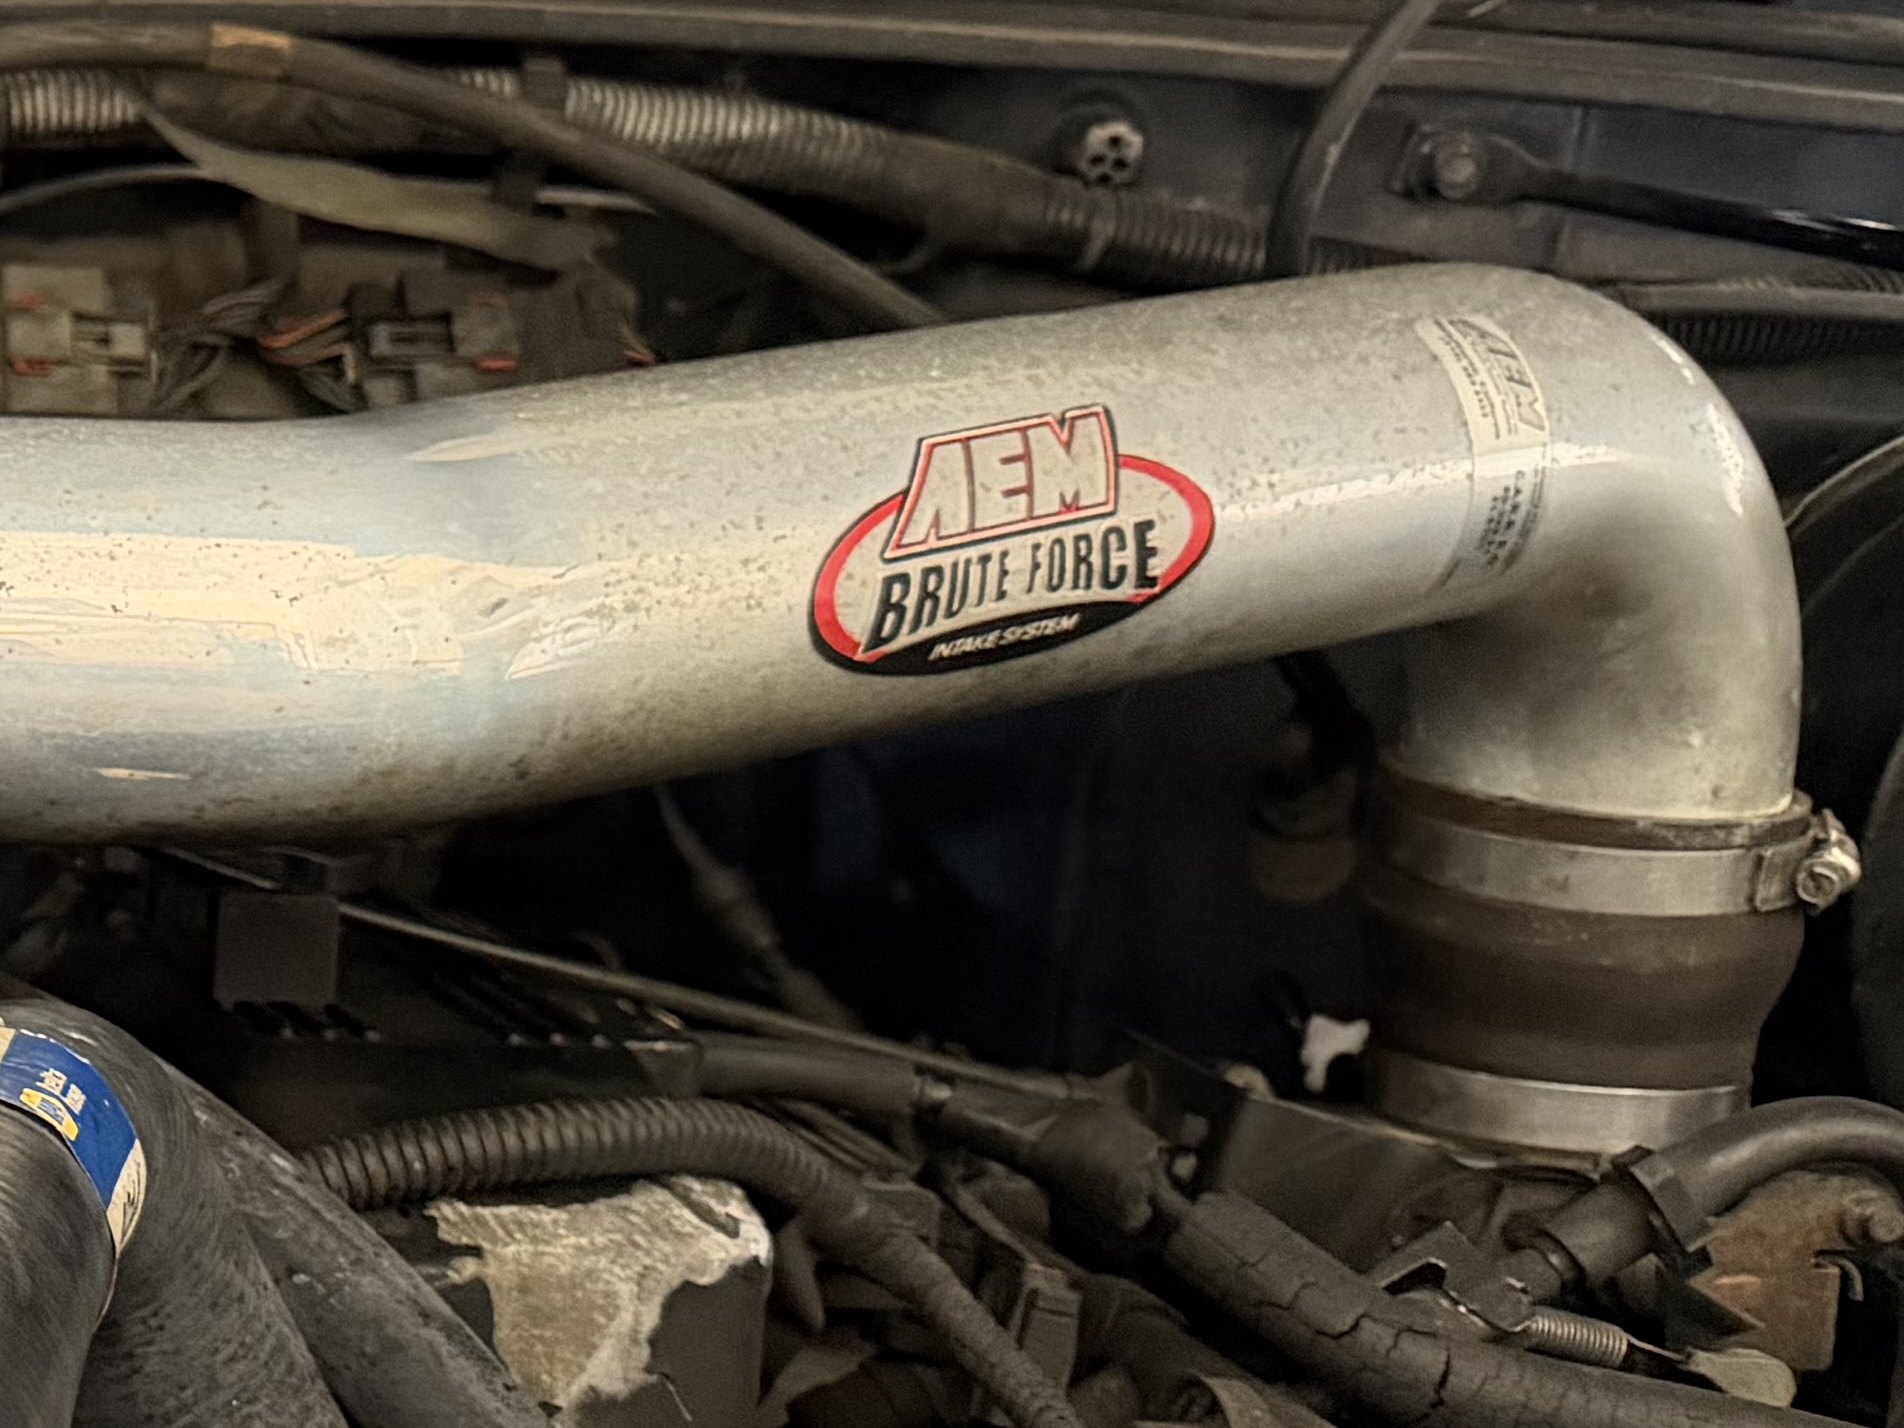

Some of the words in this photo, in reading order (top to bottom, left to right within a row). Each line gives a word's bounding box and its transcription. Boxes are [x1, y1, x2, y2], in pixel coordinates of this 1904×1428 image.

[884, 405, 1119, 560] AEM
[862, 551, 1010, 654] BRUTE
[1026, 520, 1159, 593] FORCE
[928, 629, 1002, 660] INTAKE
[998, 613, 1080, 646] SYSTEM
